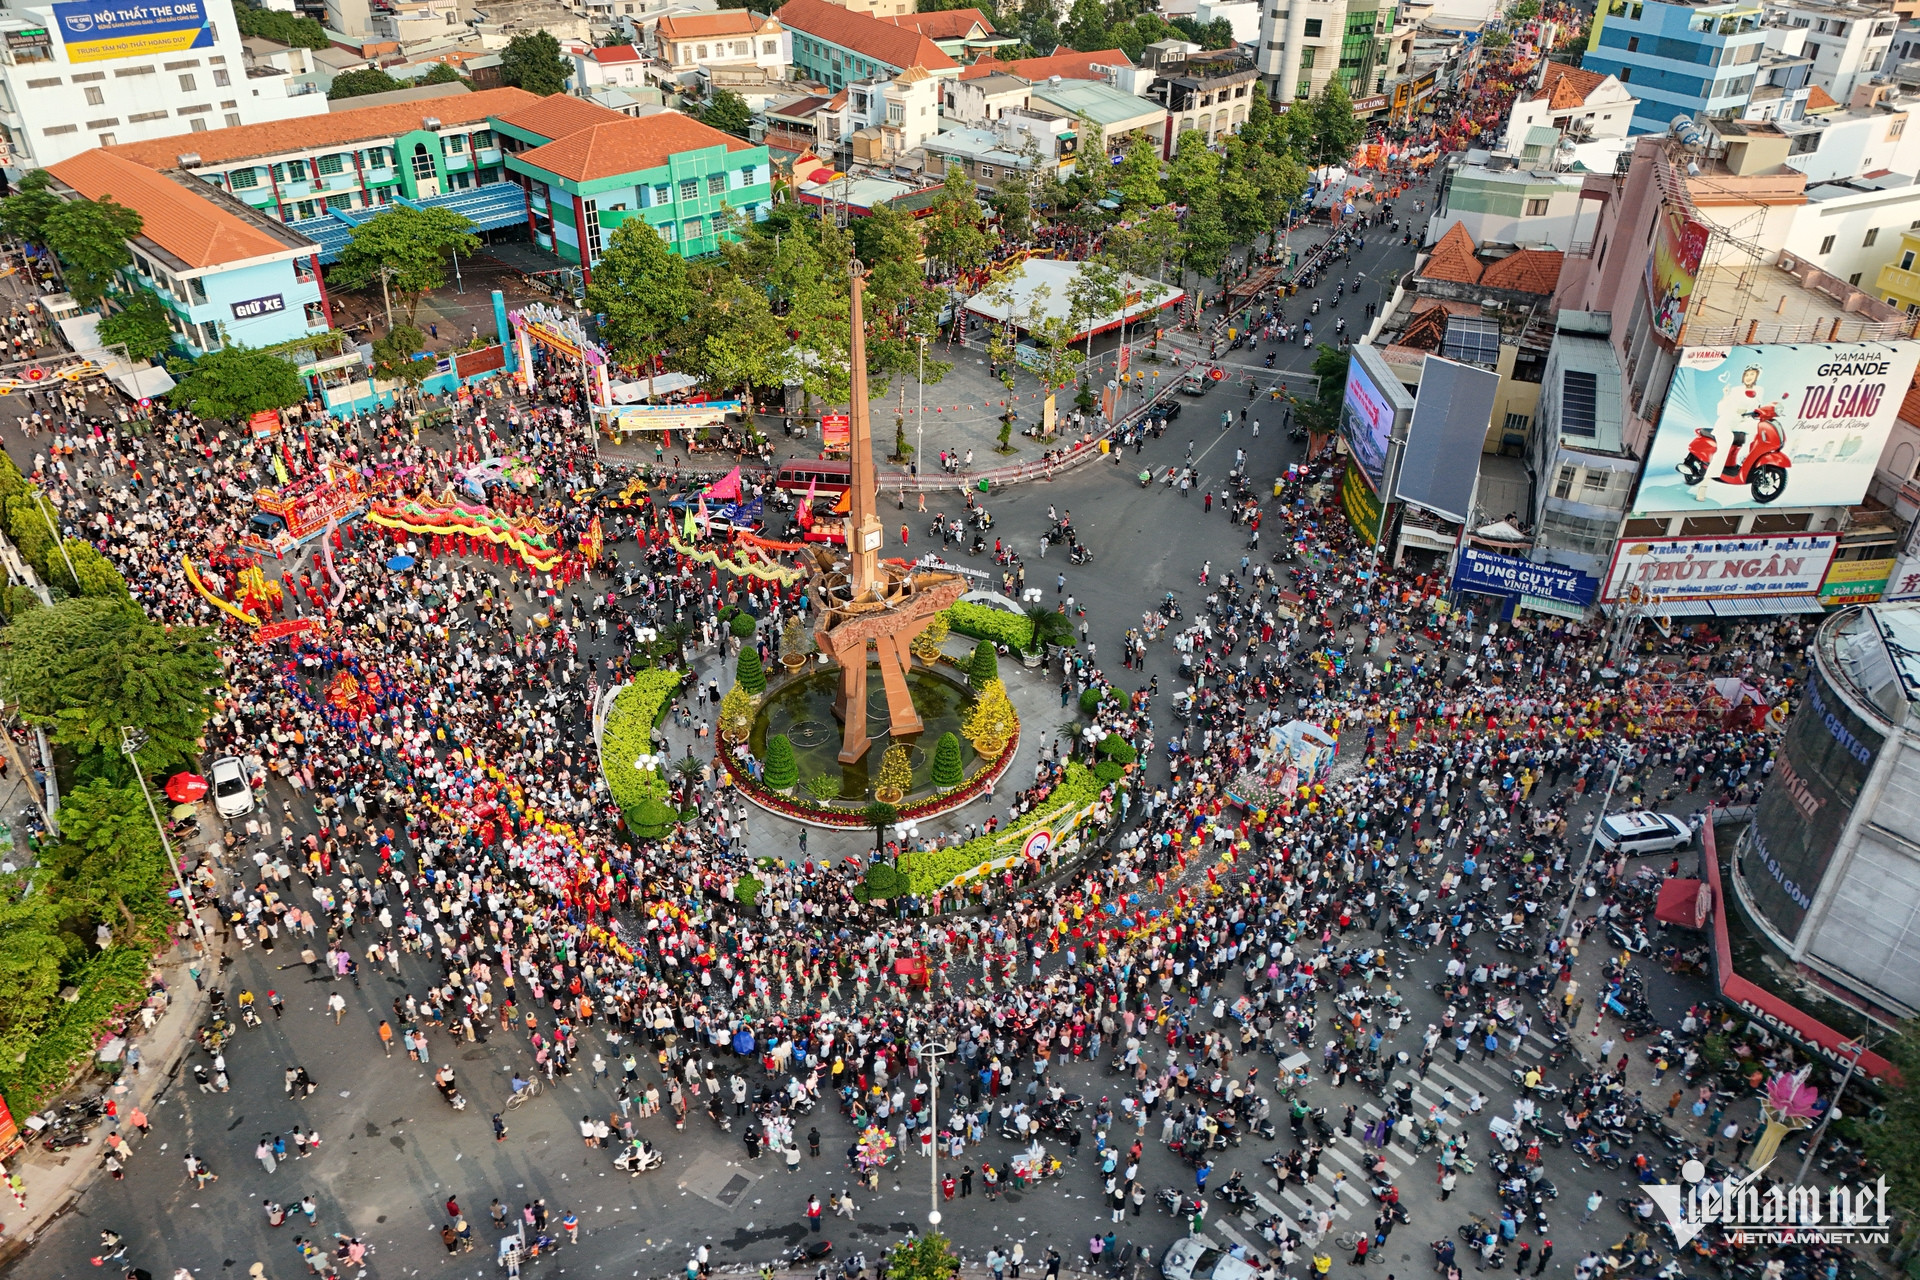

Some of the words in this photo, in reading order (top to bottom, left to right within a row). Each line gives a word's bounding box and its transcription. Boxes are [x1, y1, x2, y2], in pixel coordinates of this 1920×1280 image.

[94, 10, 116, 24] NỘI
[117, 6, 148, 20] THẤT
[150, 6, 172, 17] THE
[174, 3, 198, 14] ONE
[173, 36, 186, 44] DUY
[236, 300, 260, 316] GIỮ
[263, 298, 282, 311] XE
[1834, 352, 1882, 362] YAMAHA
[1817, 362, 1890, 377] GRANDE
[1798, 378, 1838, 419] TOẢ
[1832, 378, 1886, 418] SÁNG
[1822, 420, 1842, 430] Cách
[1654, 544, 1687, 554] TRUNG
[1802, 540, 1830, 551] LẠNH
[1473, 562, 1517, 580] DỤNG
[1543, 576, 1554, 587] Y
[1557, 577, 1577, 592] TẾ
[1639, 554, 1718, 582] THỦY
[1722, 554, 1805, 578] NGÂN
[1825, 713, 1870, 765] CENTER
[1768, 859, 1784, 883] SÀI
[1784, 880, 1810, 910] GÒN
[1742, 1000, 1867, 1077] HIGHLANDS
